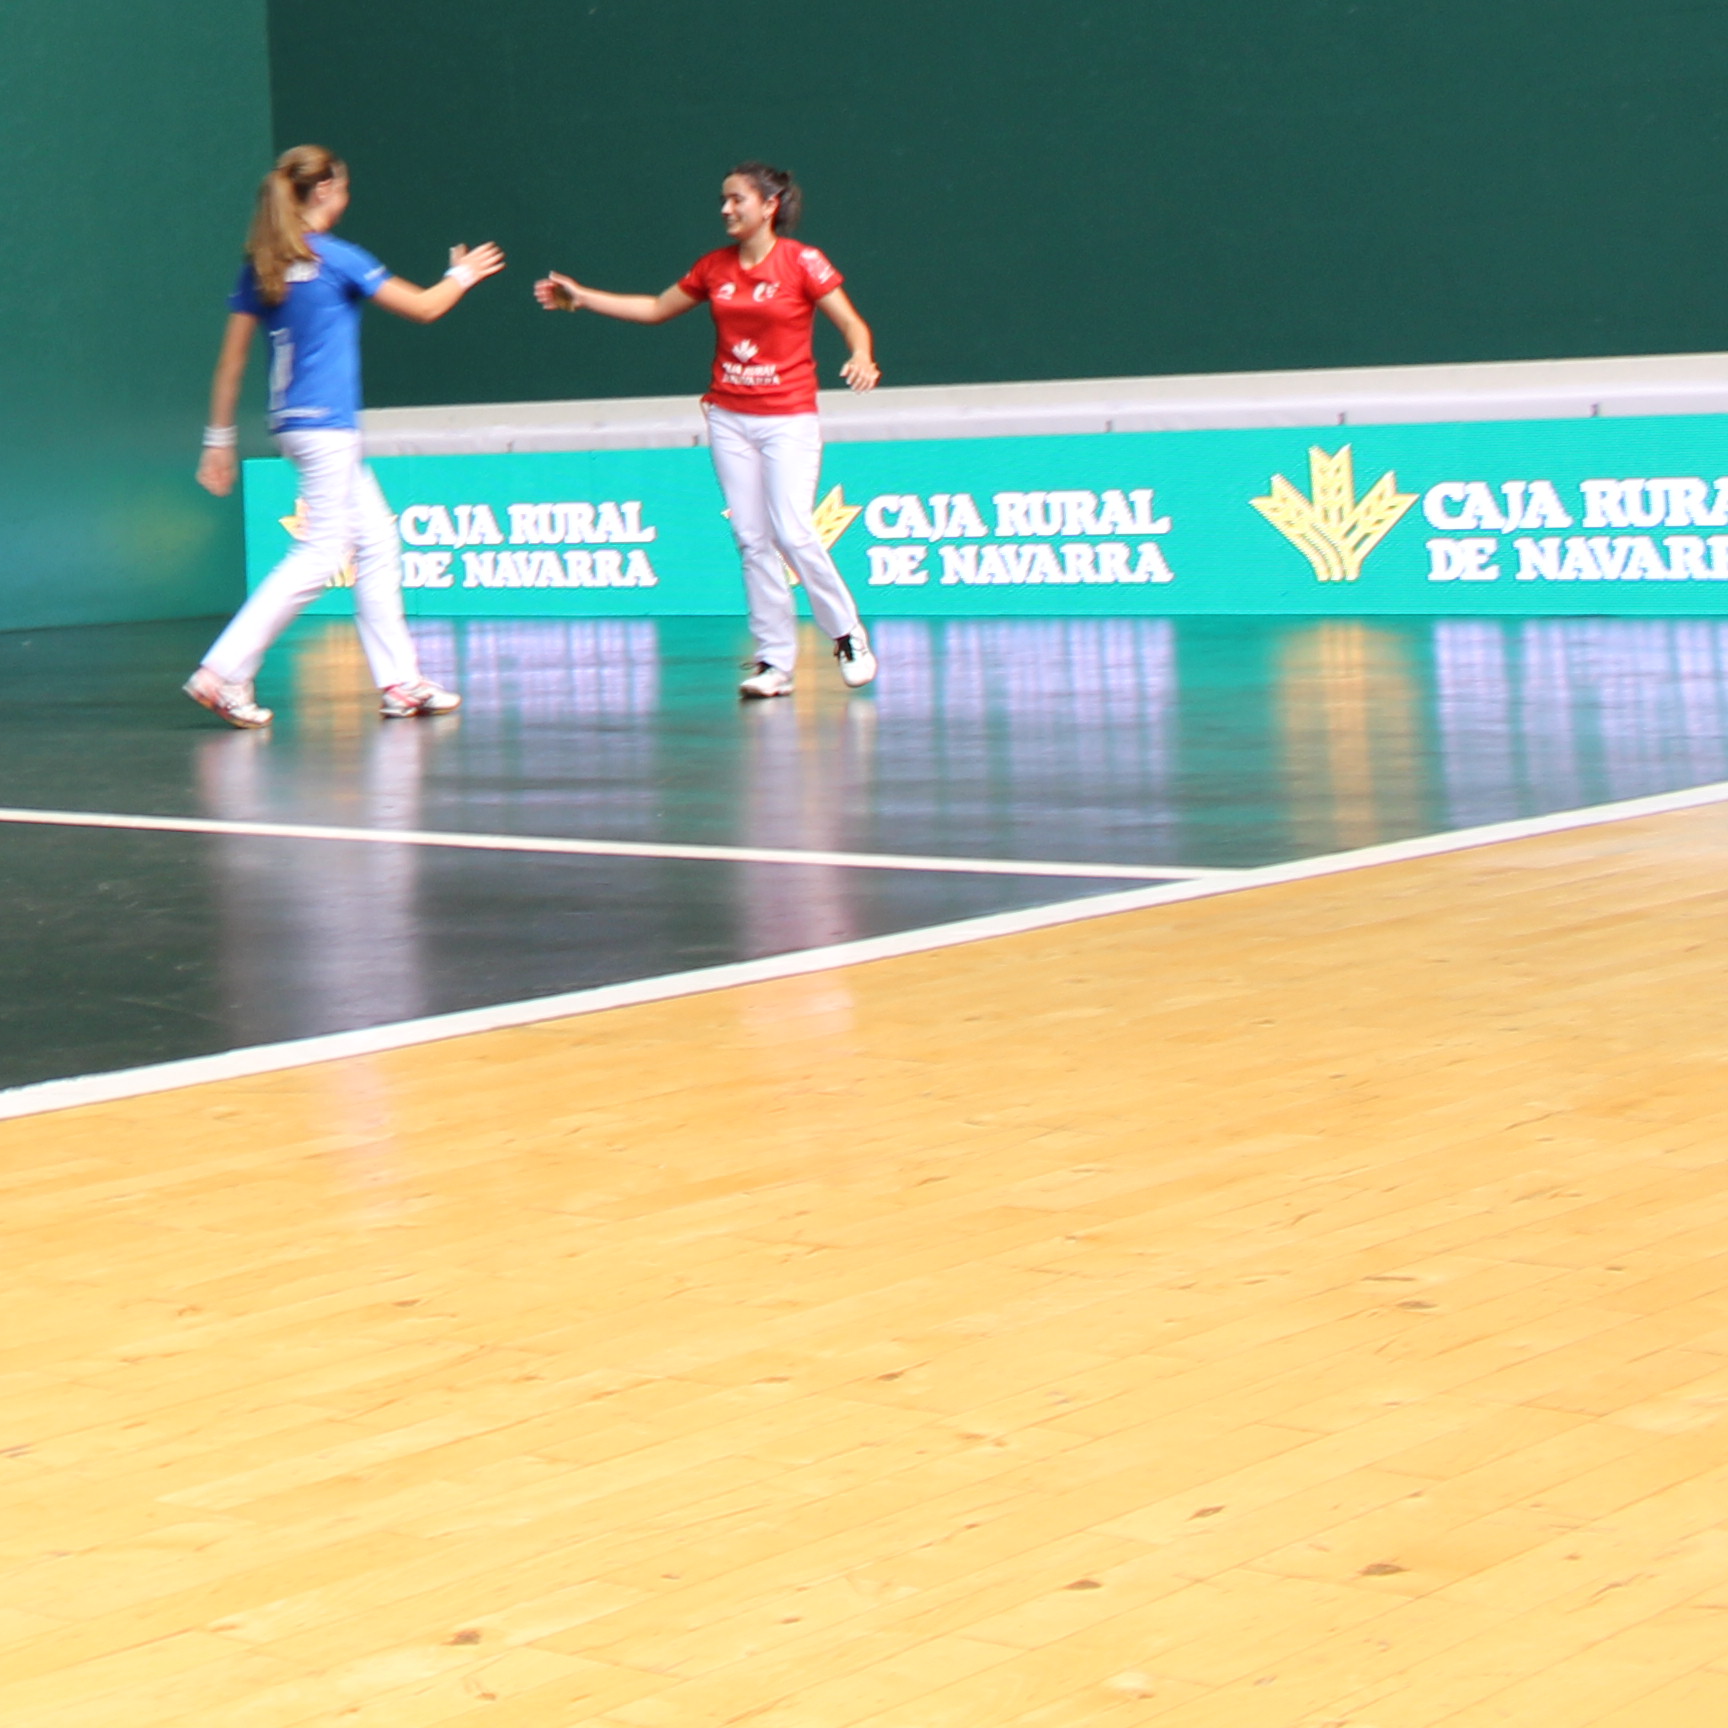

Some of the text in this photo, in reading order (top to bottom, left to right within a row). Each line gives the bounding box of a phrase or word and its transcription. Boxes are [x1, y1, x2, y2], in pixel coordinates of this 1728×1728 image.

[399, 500, 658, 549] CAJA RURAL
[864, 488, 1172, 543] CAJA RURAL
[1422, 479, 1575, 535] CAJA
[401, 549, 660, 588] DE NAVARRA
[866, 542, 1175, 586] DE NAVARRA
[1425, 536, 1501, 582] DE
